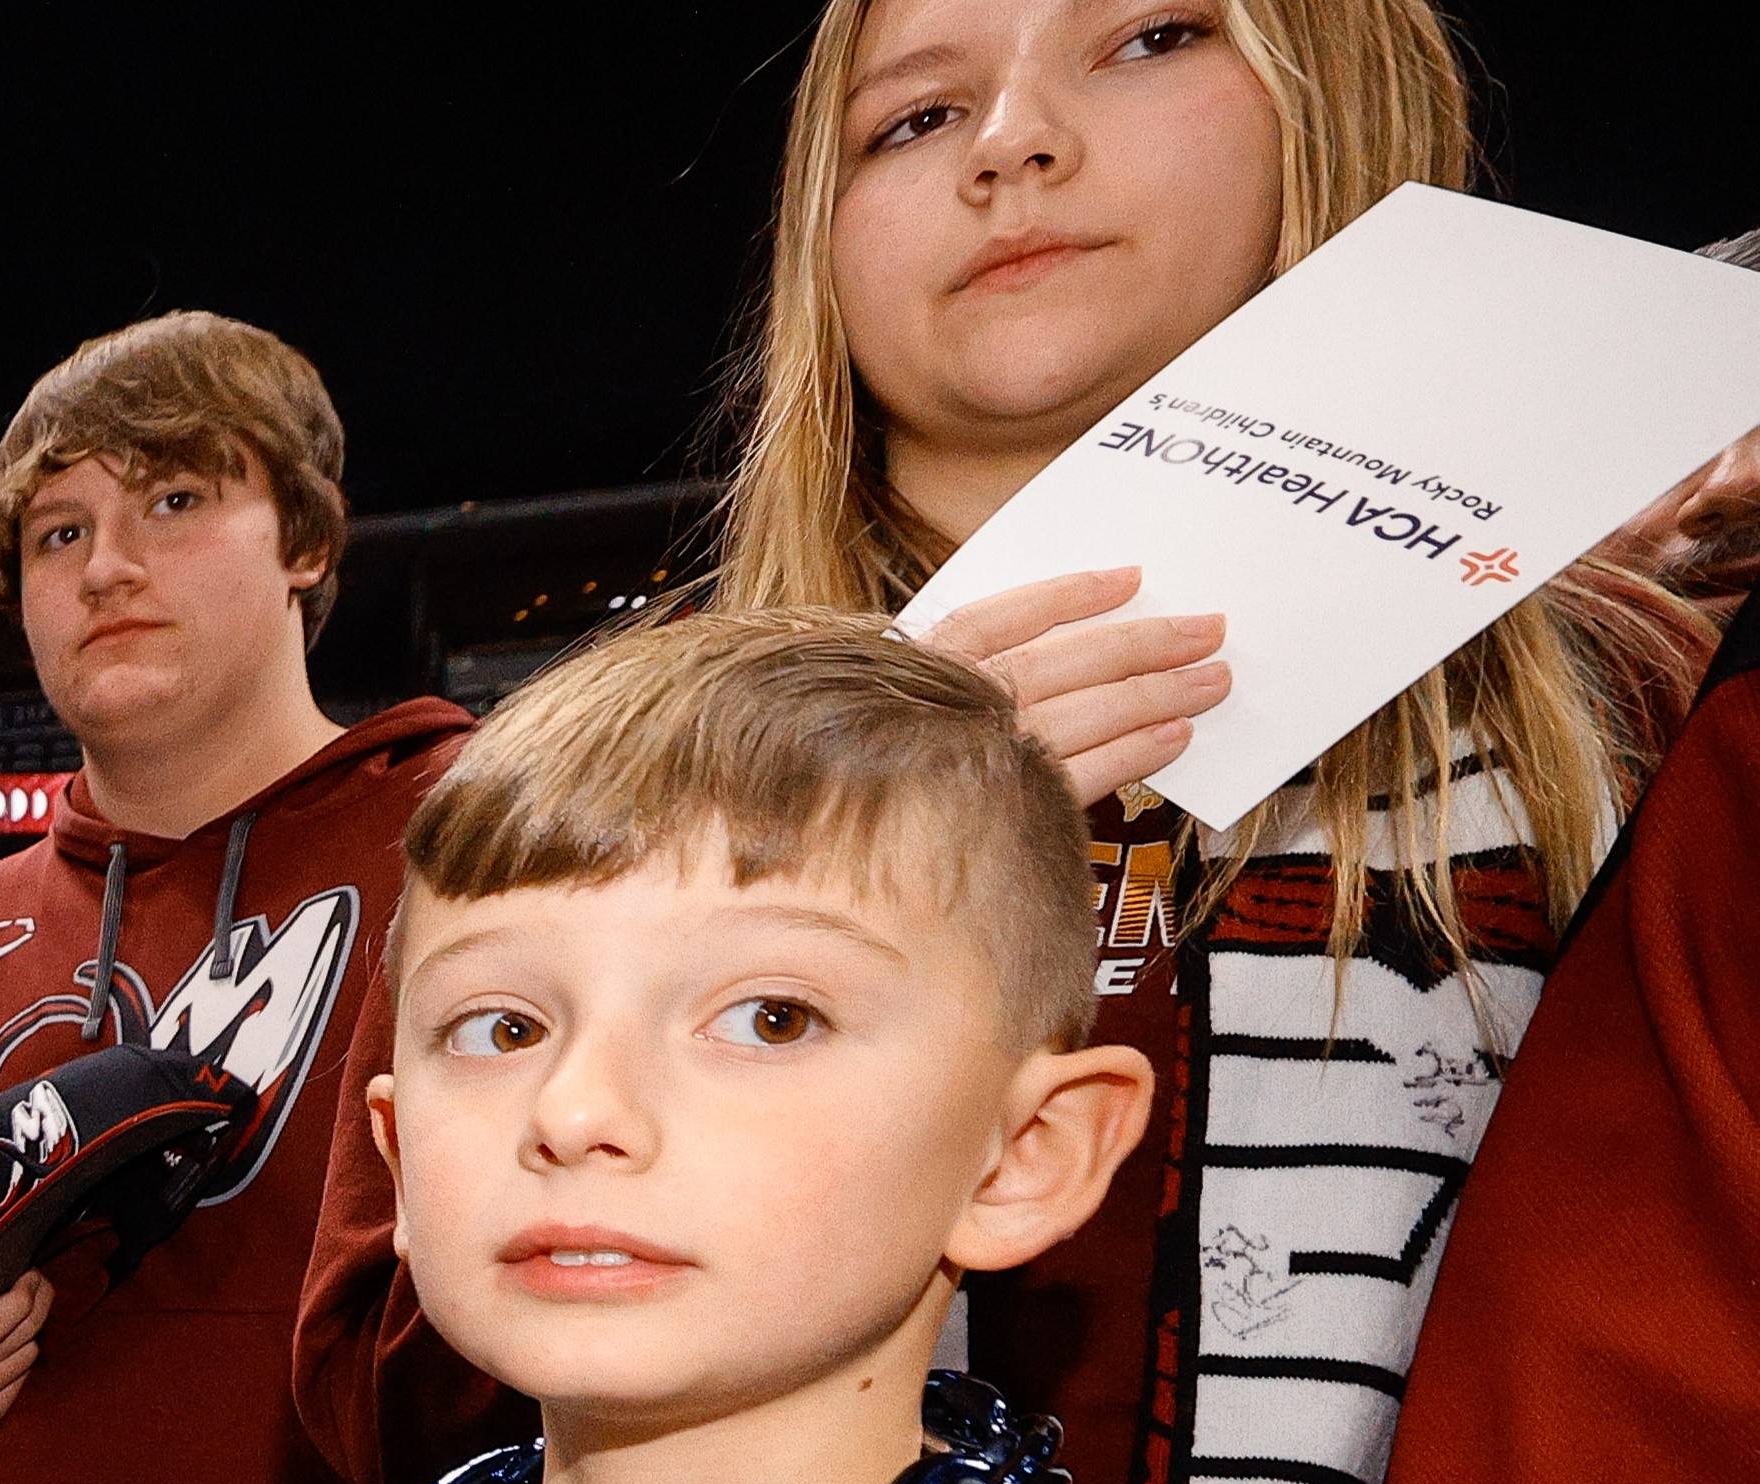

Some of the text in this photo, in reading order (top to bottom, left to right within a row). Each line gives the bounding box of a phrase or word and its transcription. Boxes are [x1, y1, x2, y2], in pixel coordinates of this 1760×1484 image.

[1098, 421, 1463, 560] HCA HealthONE
[1148, 392, 1503, 521] Rocky Mountain Children's
